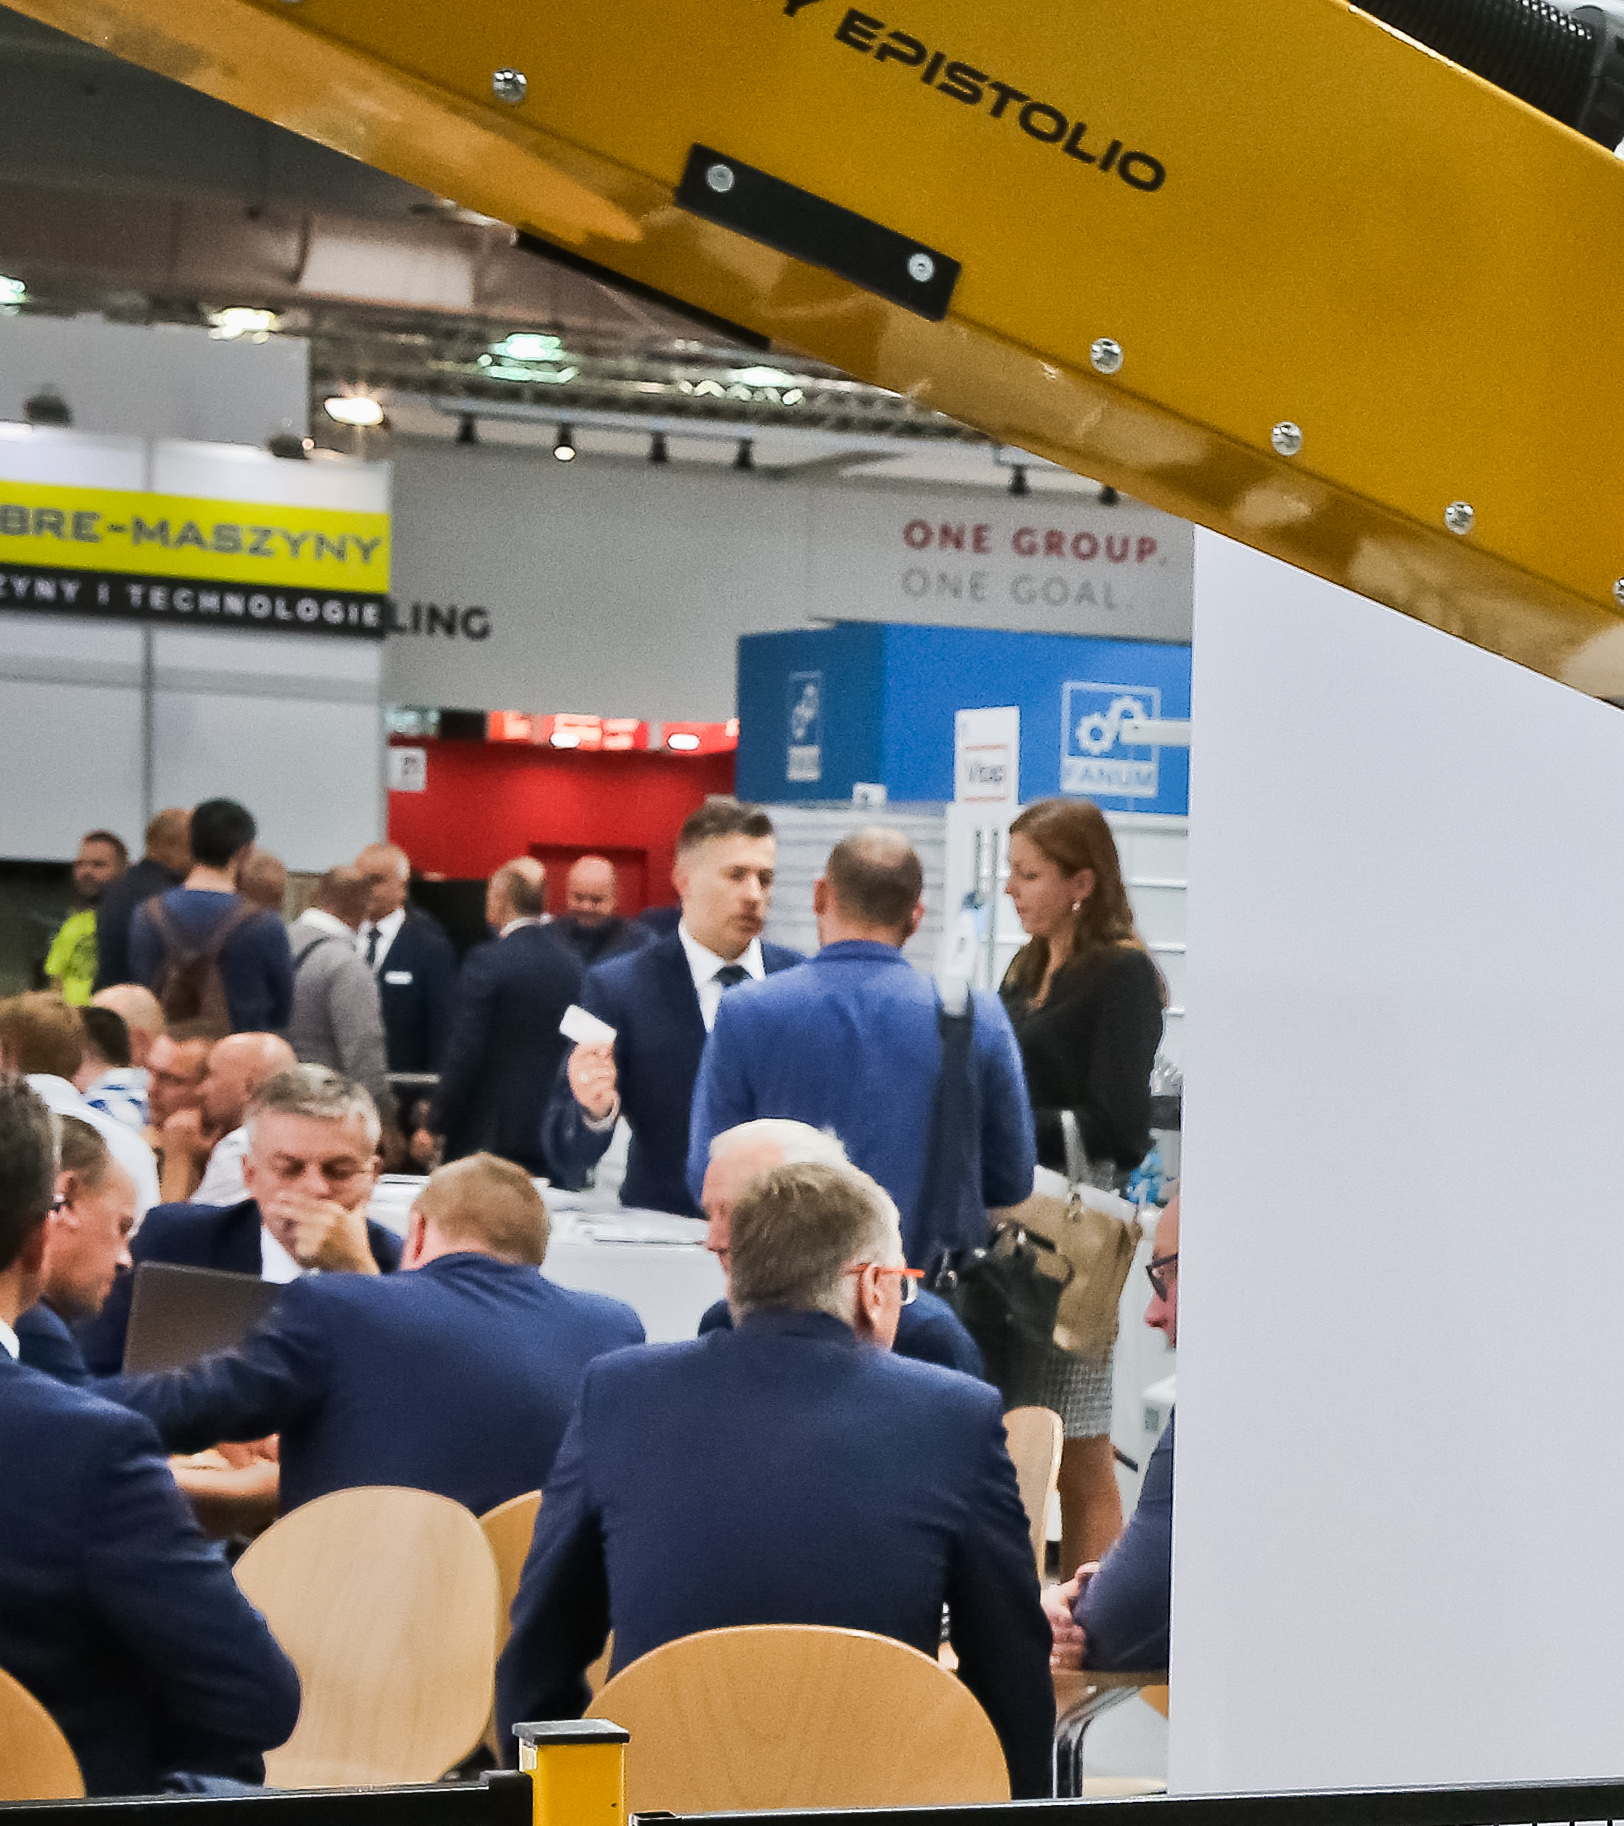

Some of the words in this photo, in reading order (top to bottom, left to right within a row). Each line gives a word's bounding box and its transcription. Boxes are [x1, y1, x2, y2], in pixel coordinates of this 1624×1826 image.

[835, 8, 1166, 192] EPISTOLIO
[903, 519, 993, 555] ONE
[902, 566, 989, 601] ONE
[127, 582, 381, 628] TECHNOLOGIE
